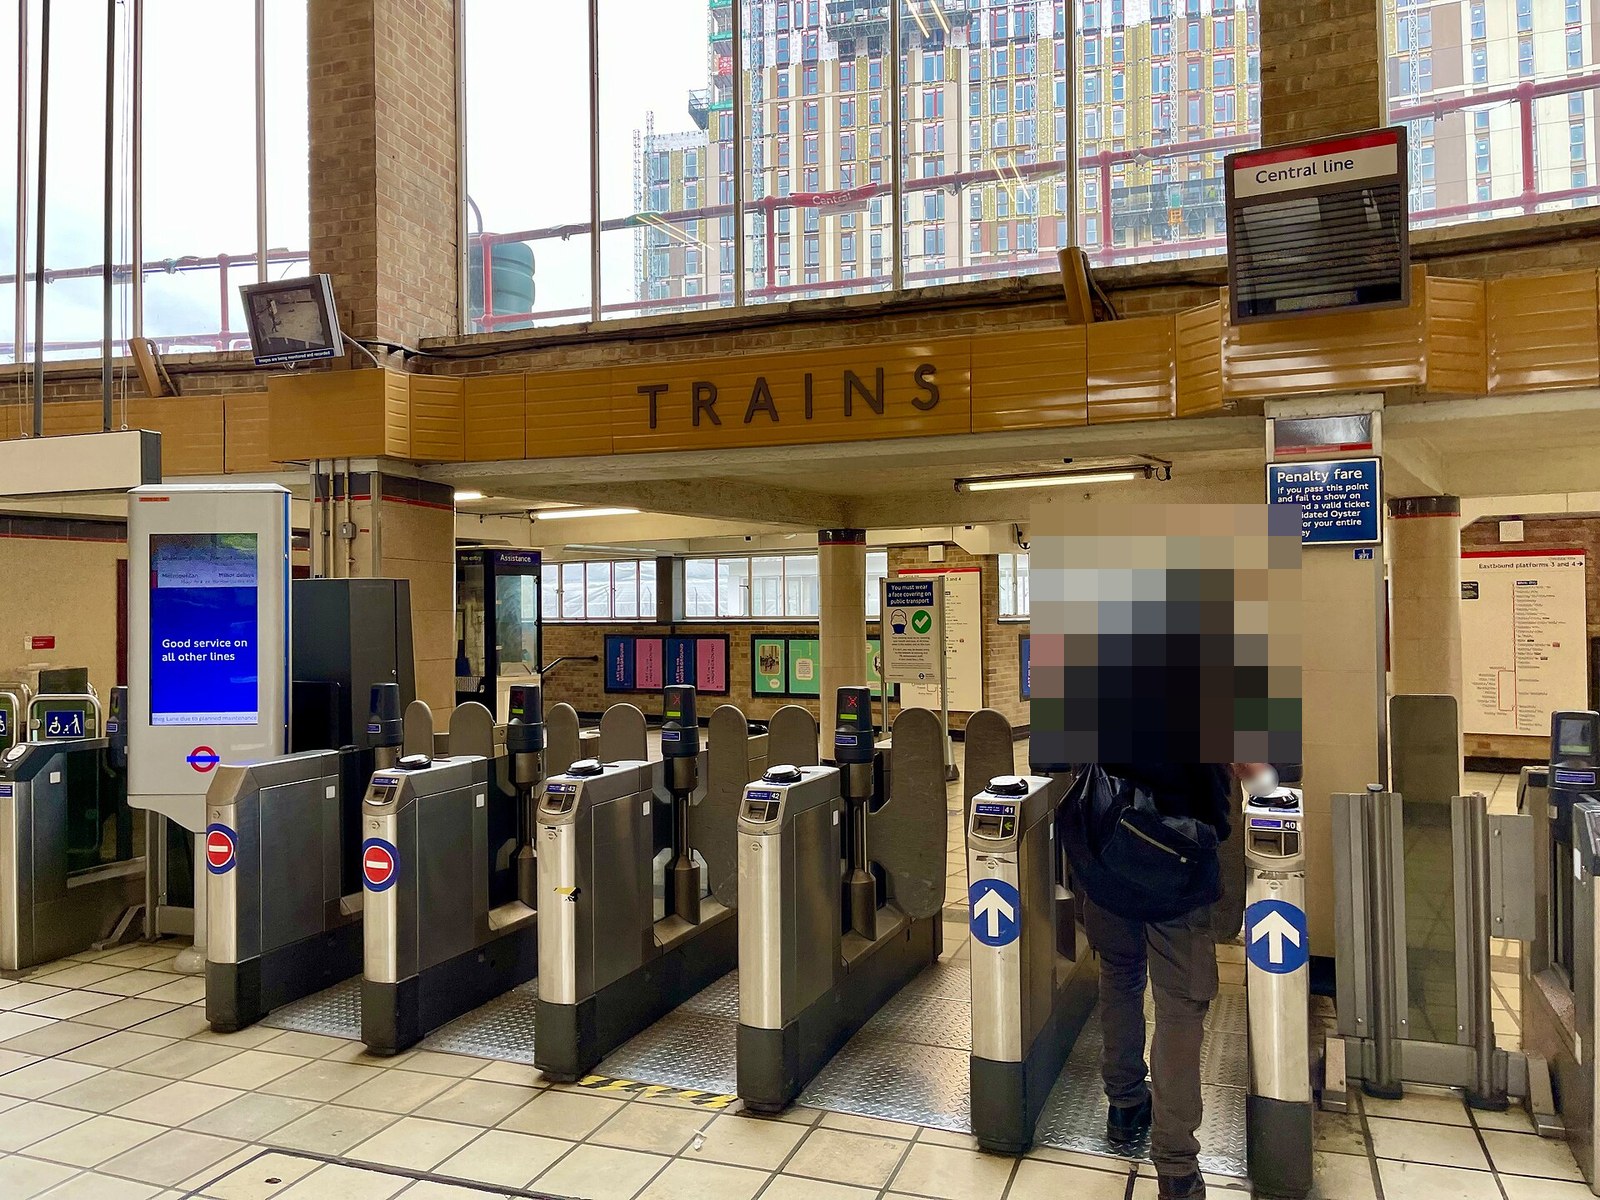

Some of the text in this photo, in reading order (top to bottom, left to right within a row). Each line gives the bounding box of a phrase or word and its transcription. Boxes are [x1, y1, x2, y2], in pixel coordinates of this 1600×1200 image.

[1255, 159, 1354, 183] Central line
[812, 192, 852, 206] Central
[637, 363, 940, 429] TRAINS
[1277, 469, 1362, 483] Penalty fare
[1286, 487, 1302, 496] you
[1304, 485, 1324, 494] pass
[1326, 483, 1343, 491] this
[1345, 482, 1369, 492] point
[1277, 494, 1293, 503] and
[1295, 493, 1309, 502] fail
[1312, 493, 1321, 501] to
[1324, 492, 1347, 500] show
[1321, 501, 1342, 509] valid
[1344, 500, 1370, 508] ticket
[1330, 510, 1361, 519] Oyster
[1314, 520, 1333, 529] your
[1335, 518, 1362, 526] entire
[500, 554, 531, 562] Assistance
[1516, 561, 1549, 569] platforms
[162, 638, 191, 648] Good
[193, 638, 231, 648] service
[162, 652, 236, 662] all other lines
